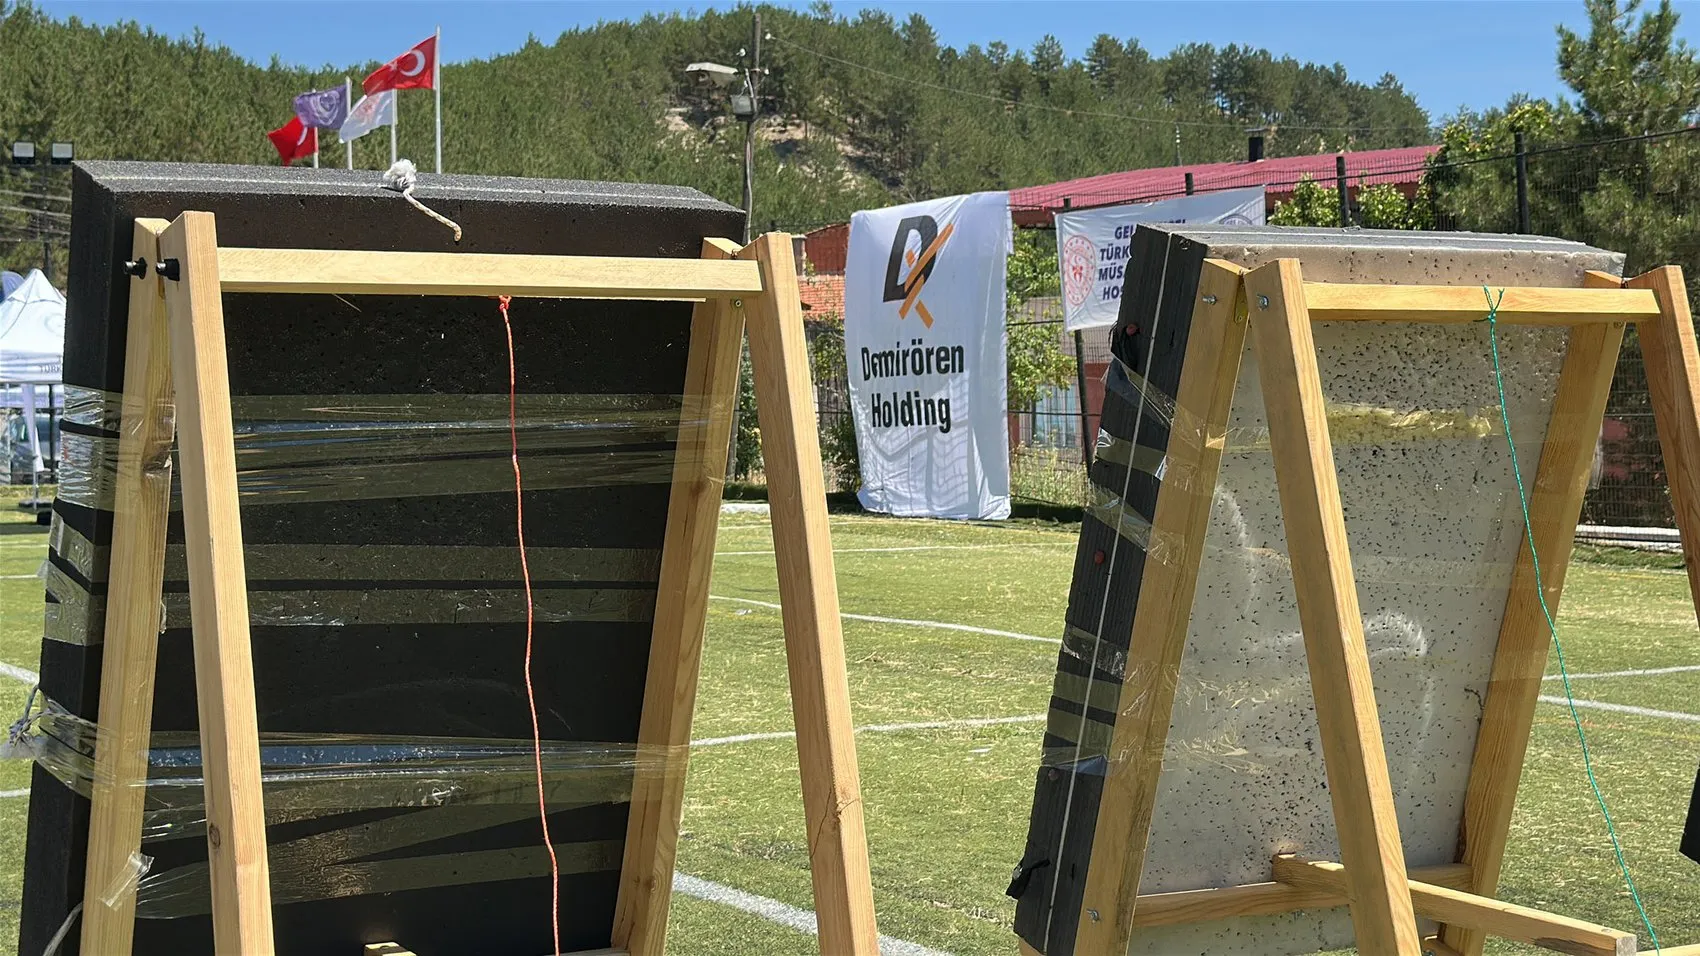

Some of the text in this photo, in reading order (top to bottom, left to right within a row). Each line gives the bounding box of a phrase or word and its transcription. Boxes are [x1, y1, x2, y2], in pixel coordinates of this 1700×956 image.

[1099, 244, 1130, 261] TÜRK
[861, 338, 965, 381] Demirören
[871, 390, 952, 433] Holding
